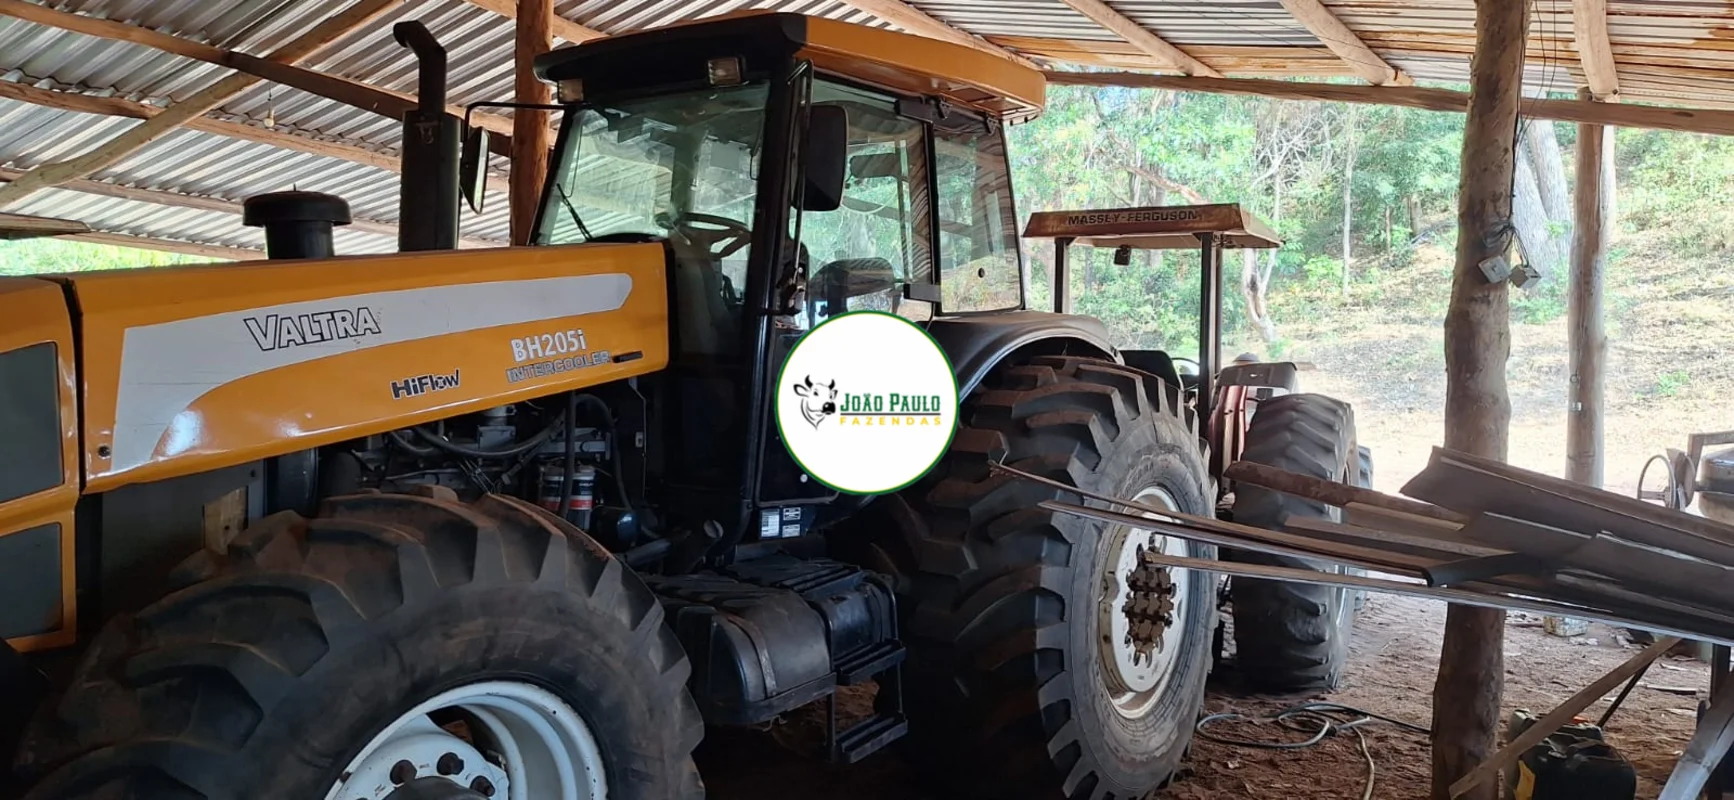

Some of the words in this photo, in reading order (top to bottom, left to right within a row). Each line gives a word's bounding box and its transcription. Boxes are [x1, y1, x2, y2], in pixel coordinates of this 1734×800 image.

[1067, 210, 1198, 225] MASSEY-FERGUSON
[243, 307, 382, 351] VALTRA
[510, 329, 587, 362] BH205i
[506, 351, 611, 383] INTERCOOLER
[390, 368, 460, 399] HiFlow
